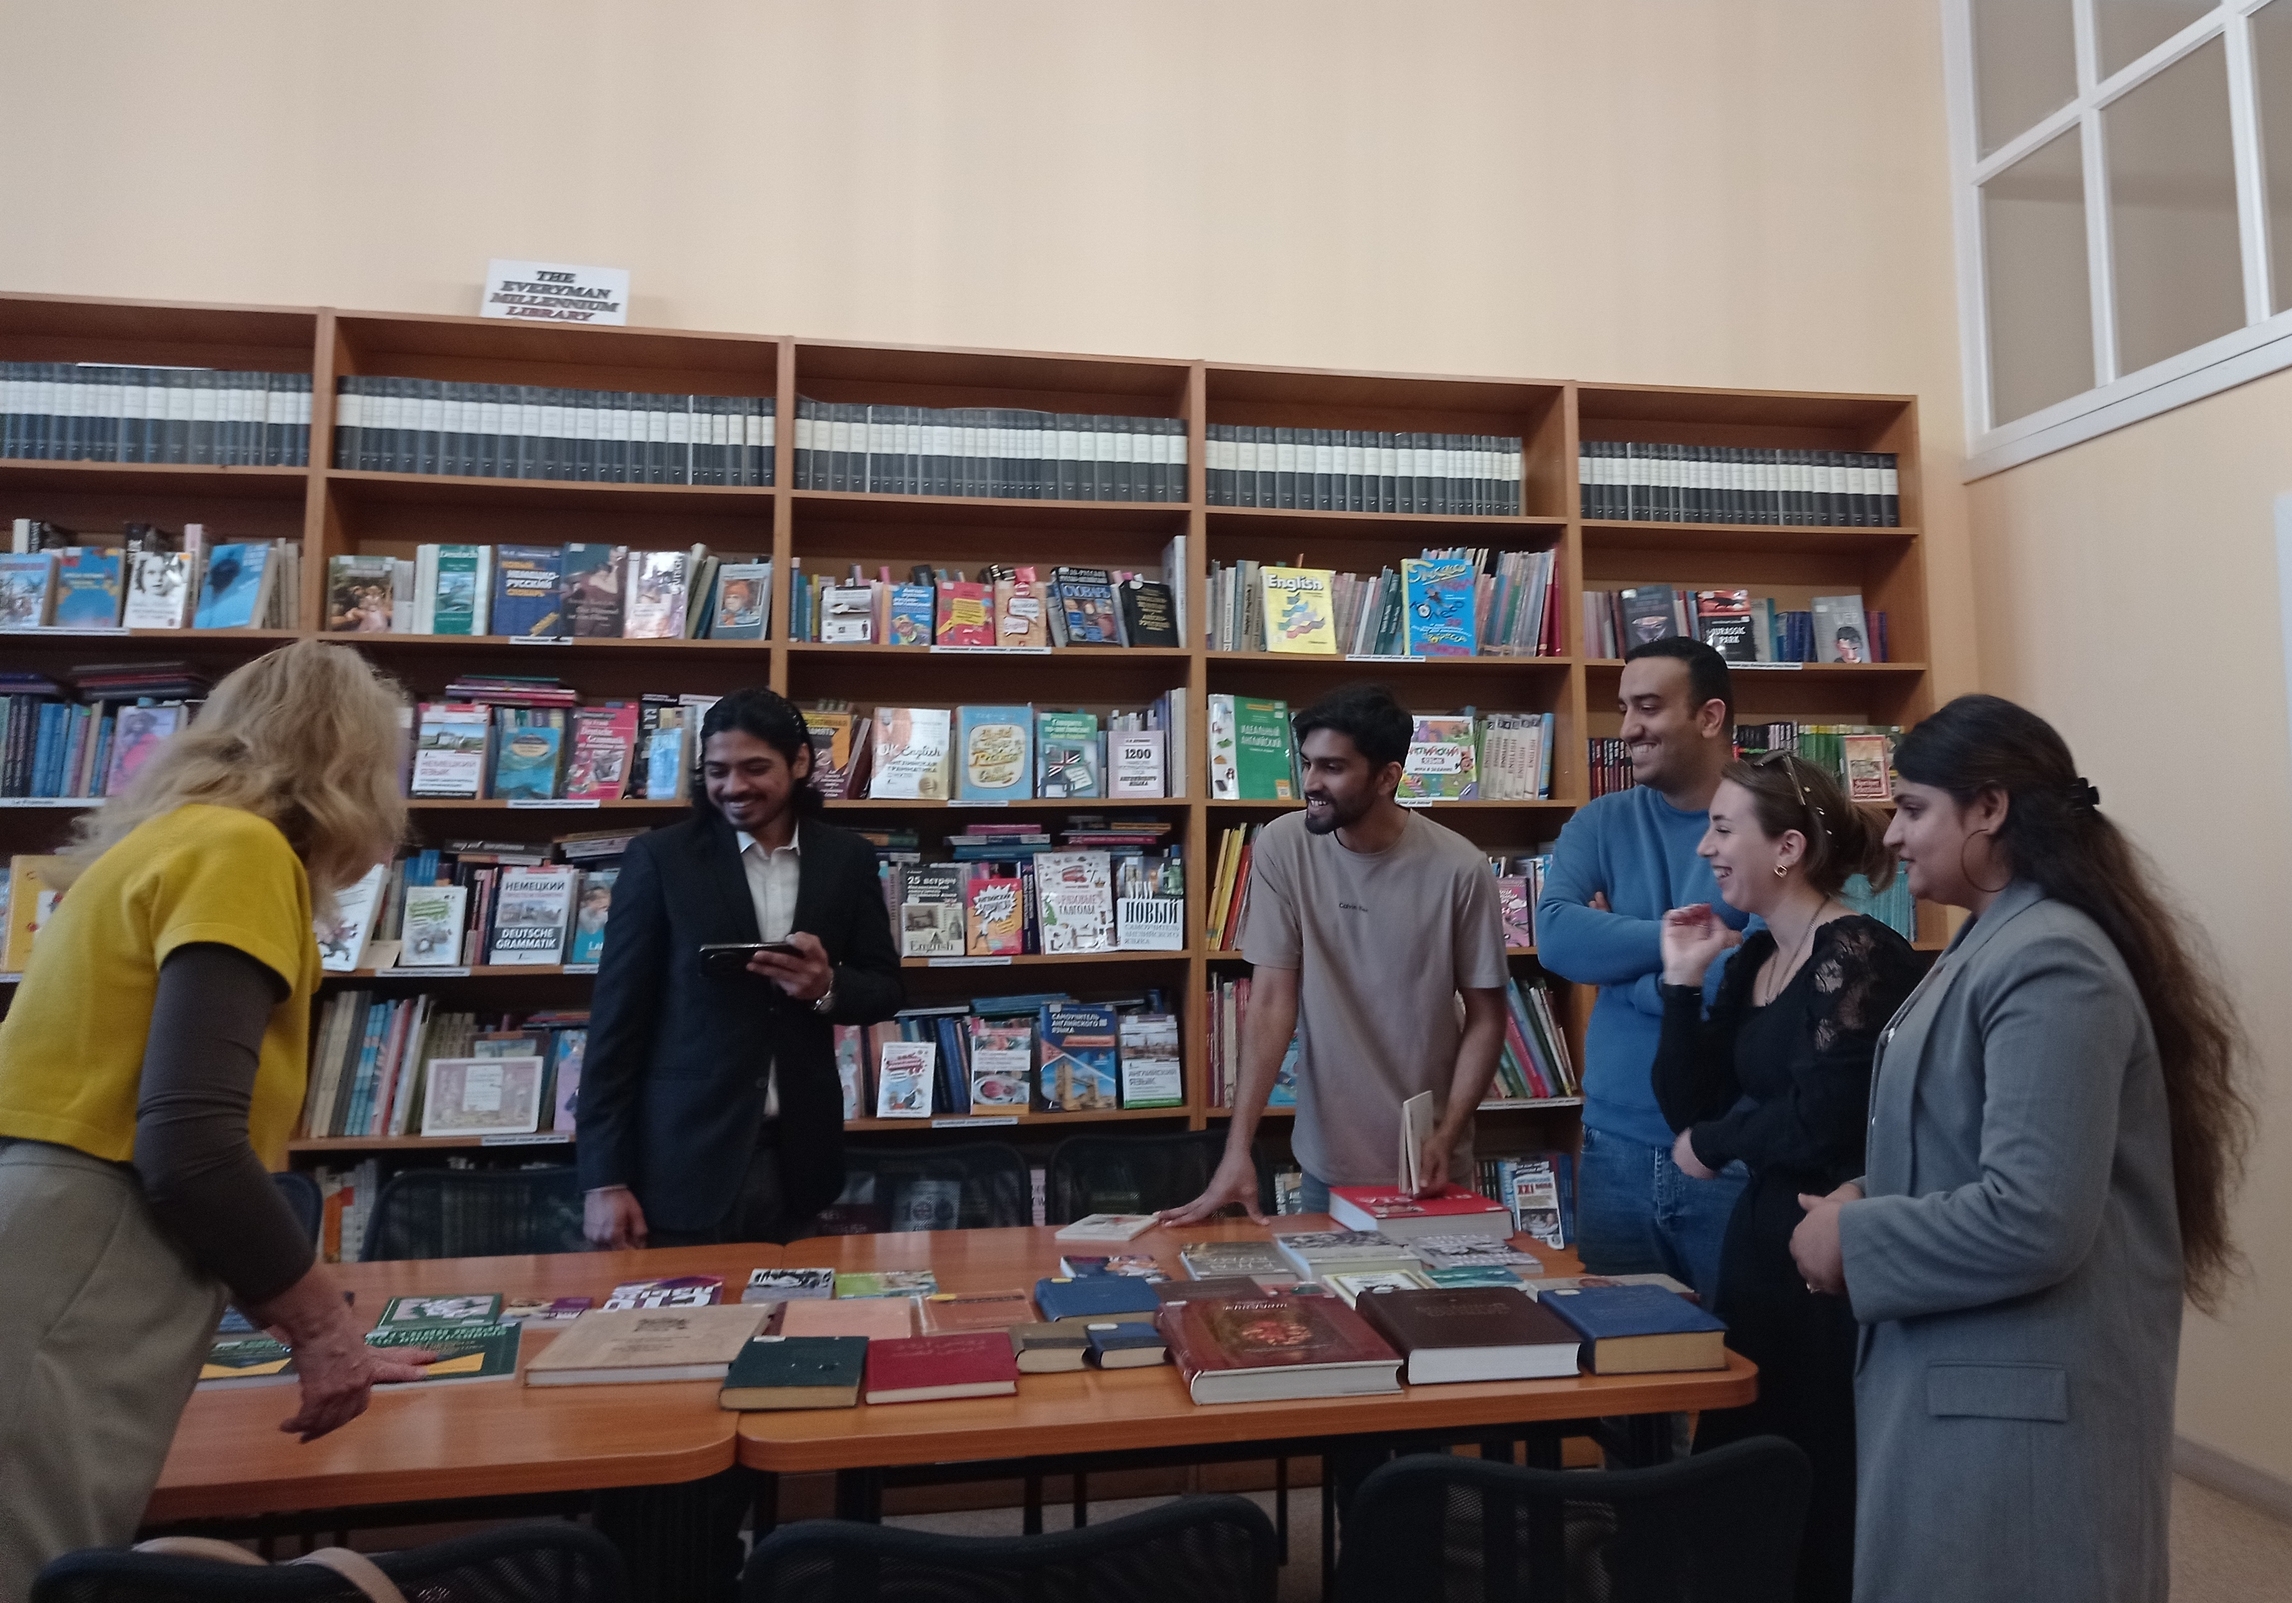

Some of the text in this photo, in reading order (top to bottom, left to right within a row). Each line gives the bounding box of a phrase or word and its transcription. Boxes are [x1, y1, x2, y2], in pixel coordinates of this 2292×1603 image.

[536, 270, 576, 283] THE
[500, 281, 612, 299] EVERYMAN
[490, 293, 620, 312] MILLENNIUM
[506, 306, 595, 321] LIBRARY
[1268, 574, 1324, 591] English
[1064, 585, 1111, 598] СЛОВАРЬ
[1707, 626, 1746, 636] JURASSIC
[1719, 636, 1740, 644] PARK
[1124, 748, 1152, 760] 1200
[1508, 739, 1517, 774] ENGLISH
[505, 881, 565, 891] НЕМЕЦКИЙ
[907, 876, 921, 885] 25
[1125, 898, 1178, 924] НОВЫЙ
[502, 928, 554, 938] DEUTSCHE
[496, 938, 556, 949] GRAMMATIK
[1518, 1183, 1534, 1195] XXI
